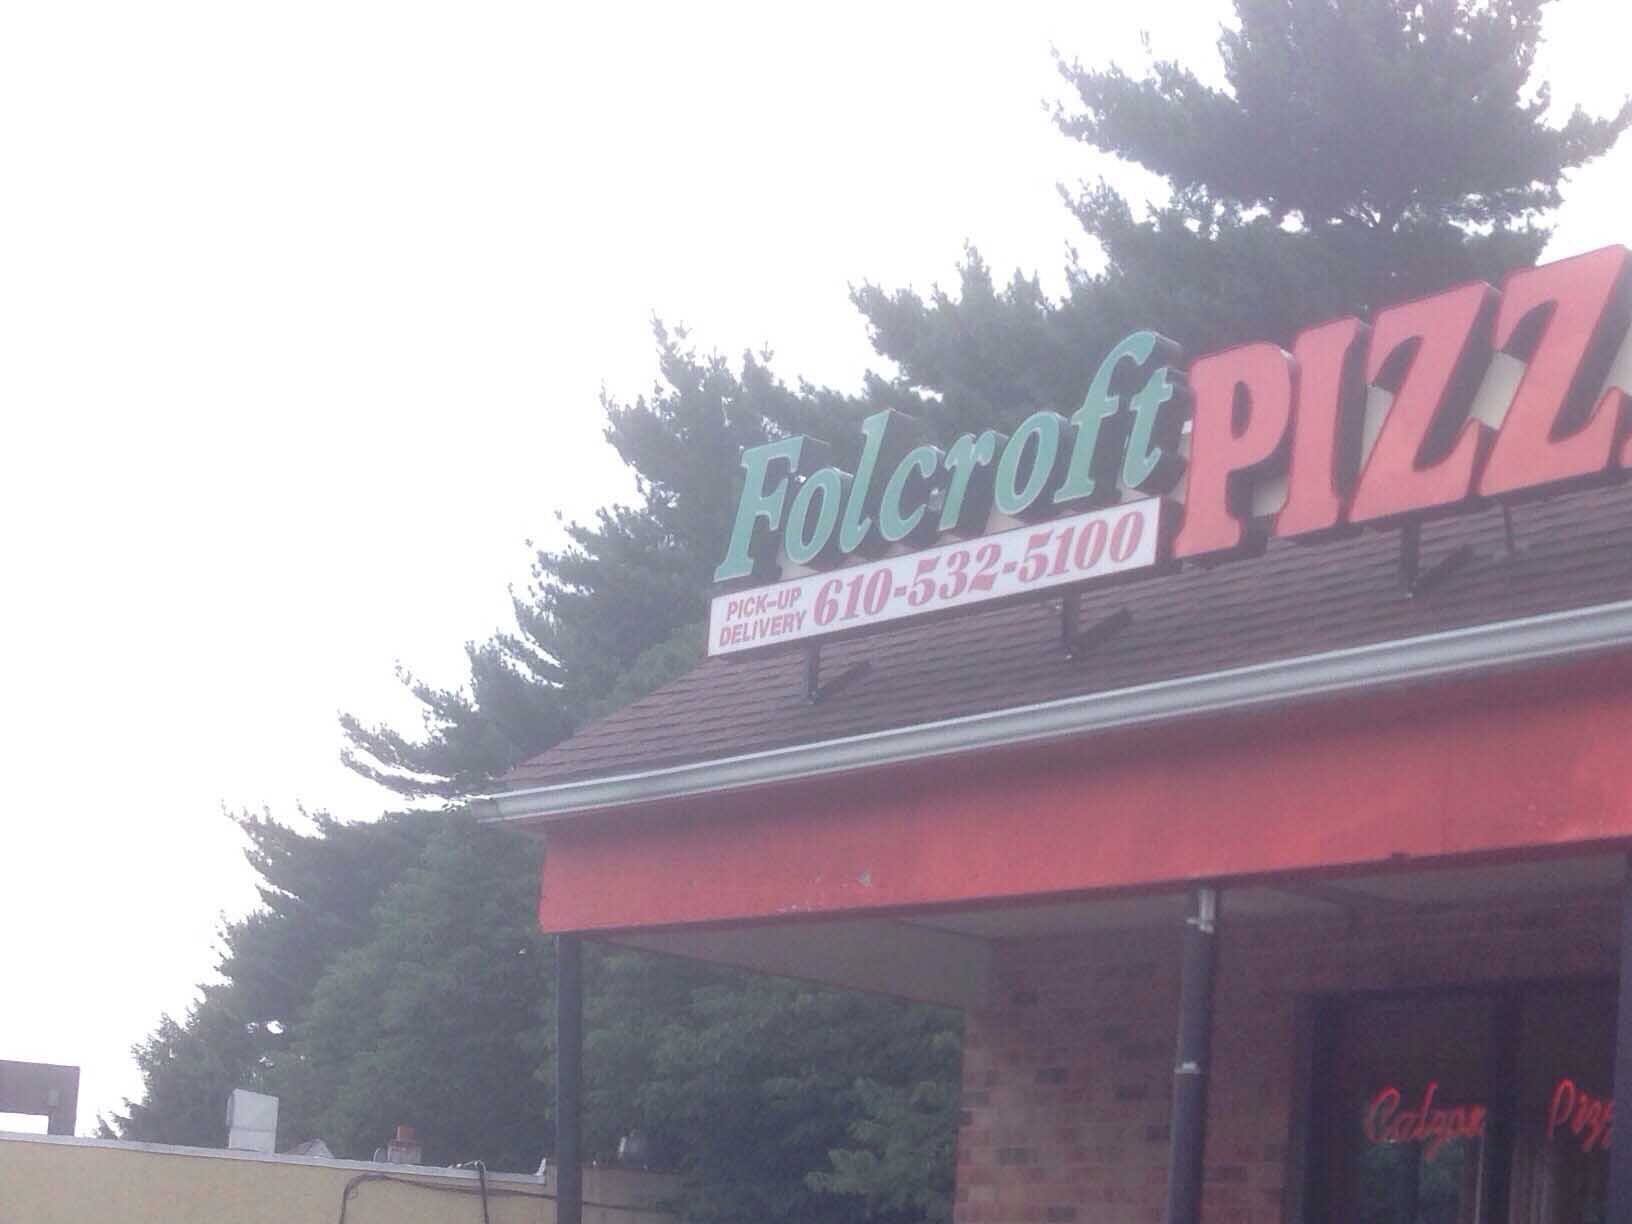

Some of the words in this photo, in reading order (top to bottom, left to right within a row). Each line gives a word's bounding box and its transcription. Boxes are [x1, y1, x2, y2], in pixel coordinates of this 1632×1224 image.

[713, 329, 1175, 583] Folcroft
[726, 586, 802, 621] PICK-UP
[812, 510, 1146, 627] 610-532-5100
[719, 609, 807, 647] DELIVERY
